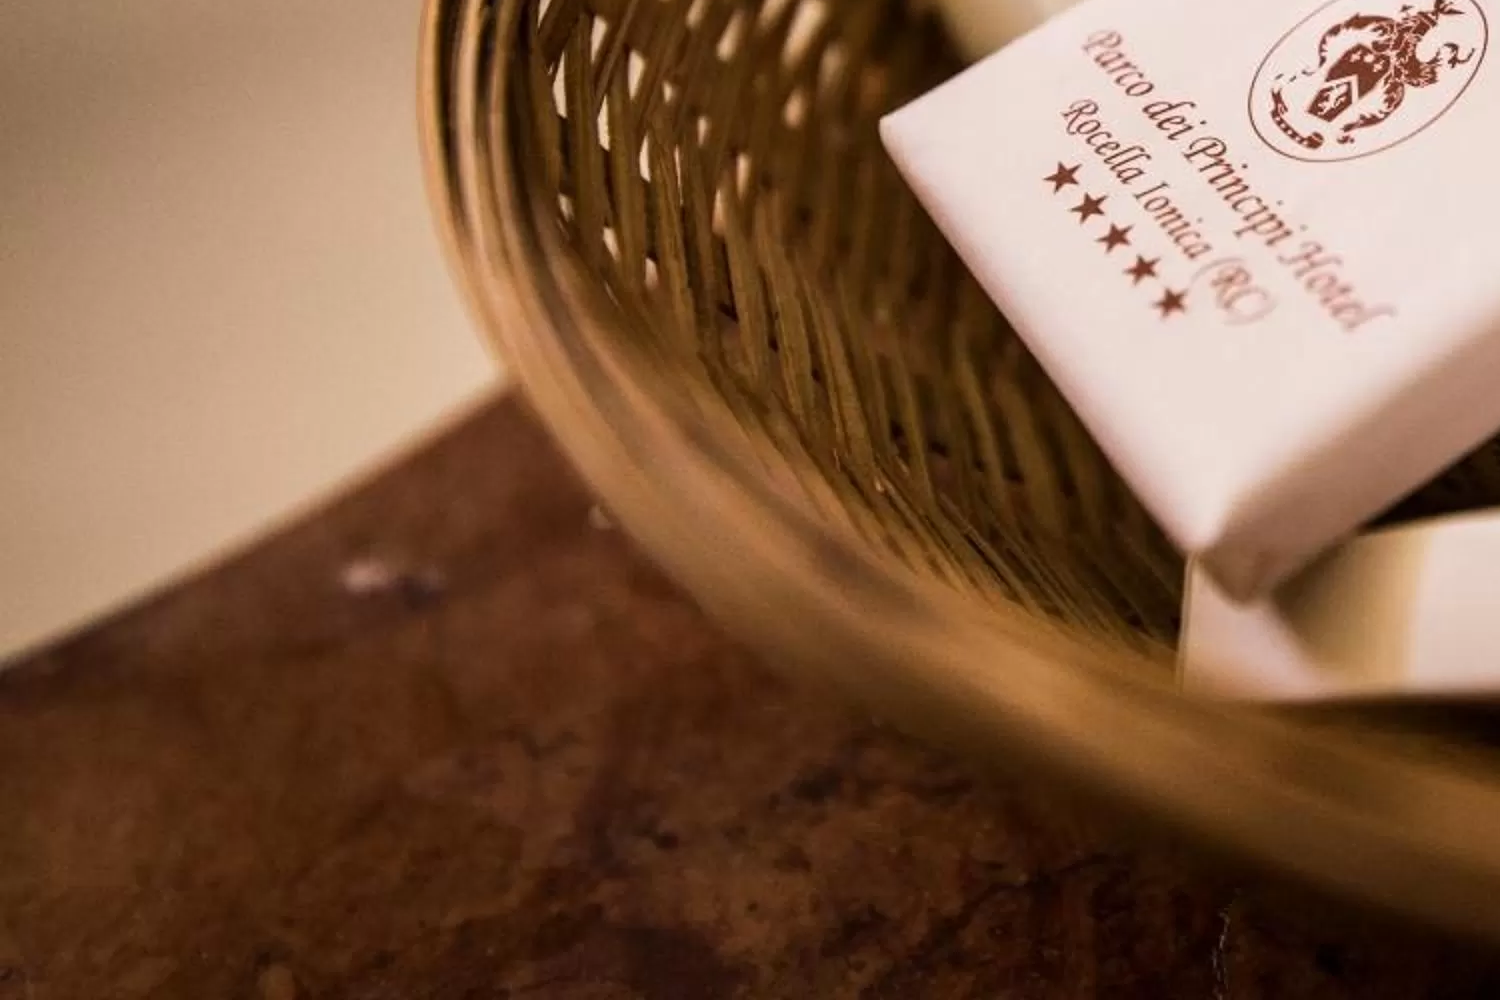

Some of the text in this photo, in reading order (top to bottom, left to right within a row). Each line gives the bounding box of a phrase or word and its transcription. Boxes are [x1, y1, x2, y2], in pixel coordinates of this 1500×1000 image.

[1061, 98, 1152, 185] Rocella
[1133, 180, 1213, 260] Ionica
[1081, 29, 1155, 97] Parco
[1141, 100, 1207, 141] dei
[1182, 136, 1308, 247] Principi
[1277, 241, 1397, 332] Hotel
